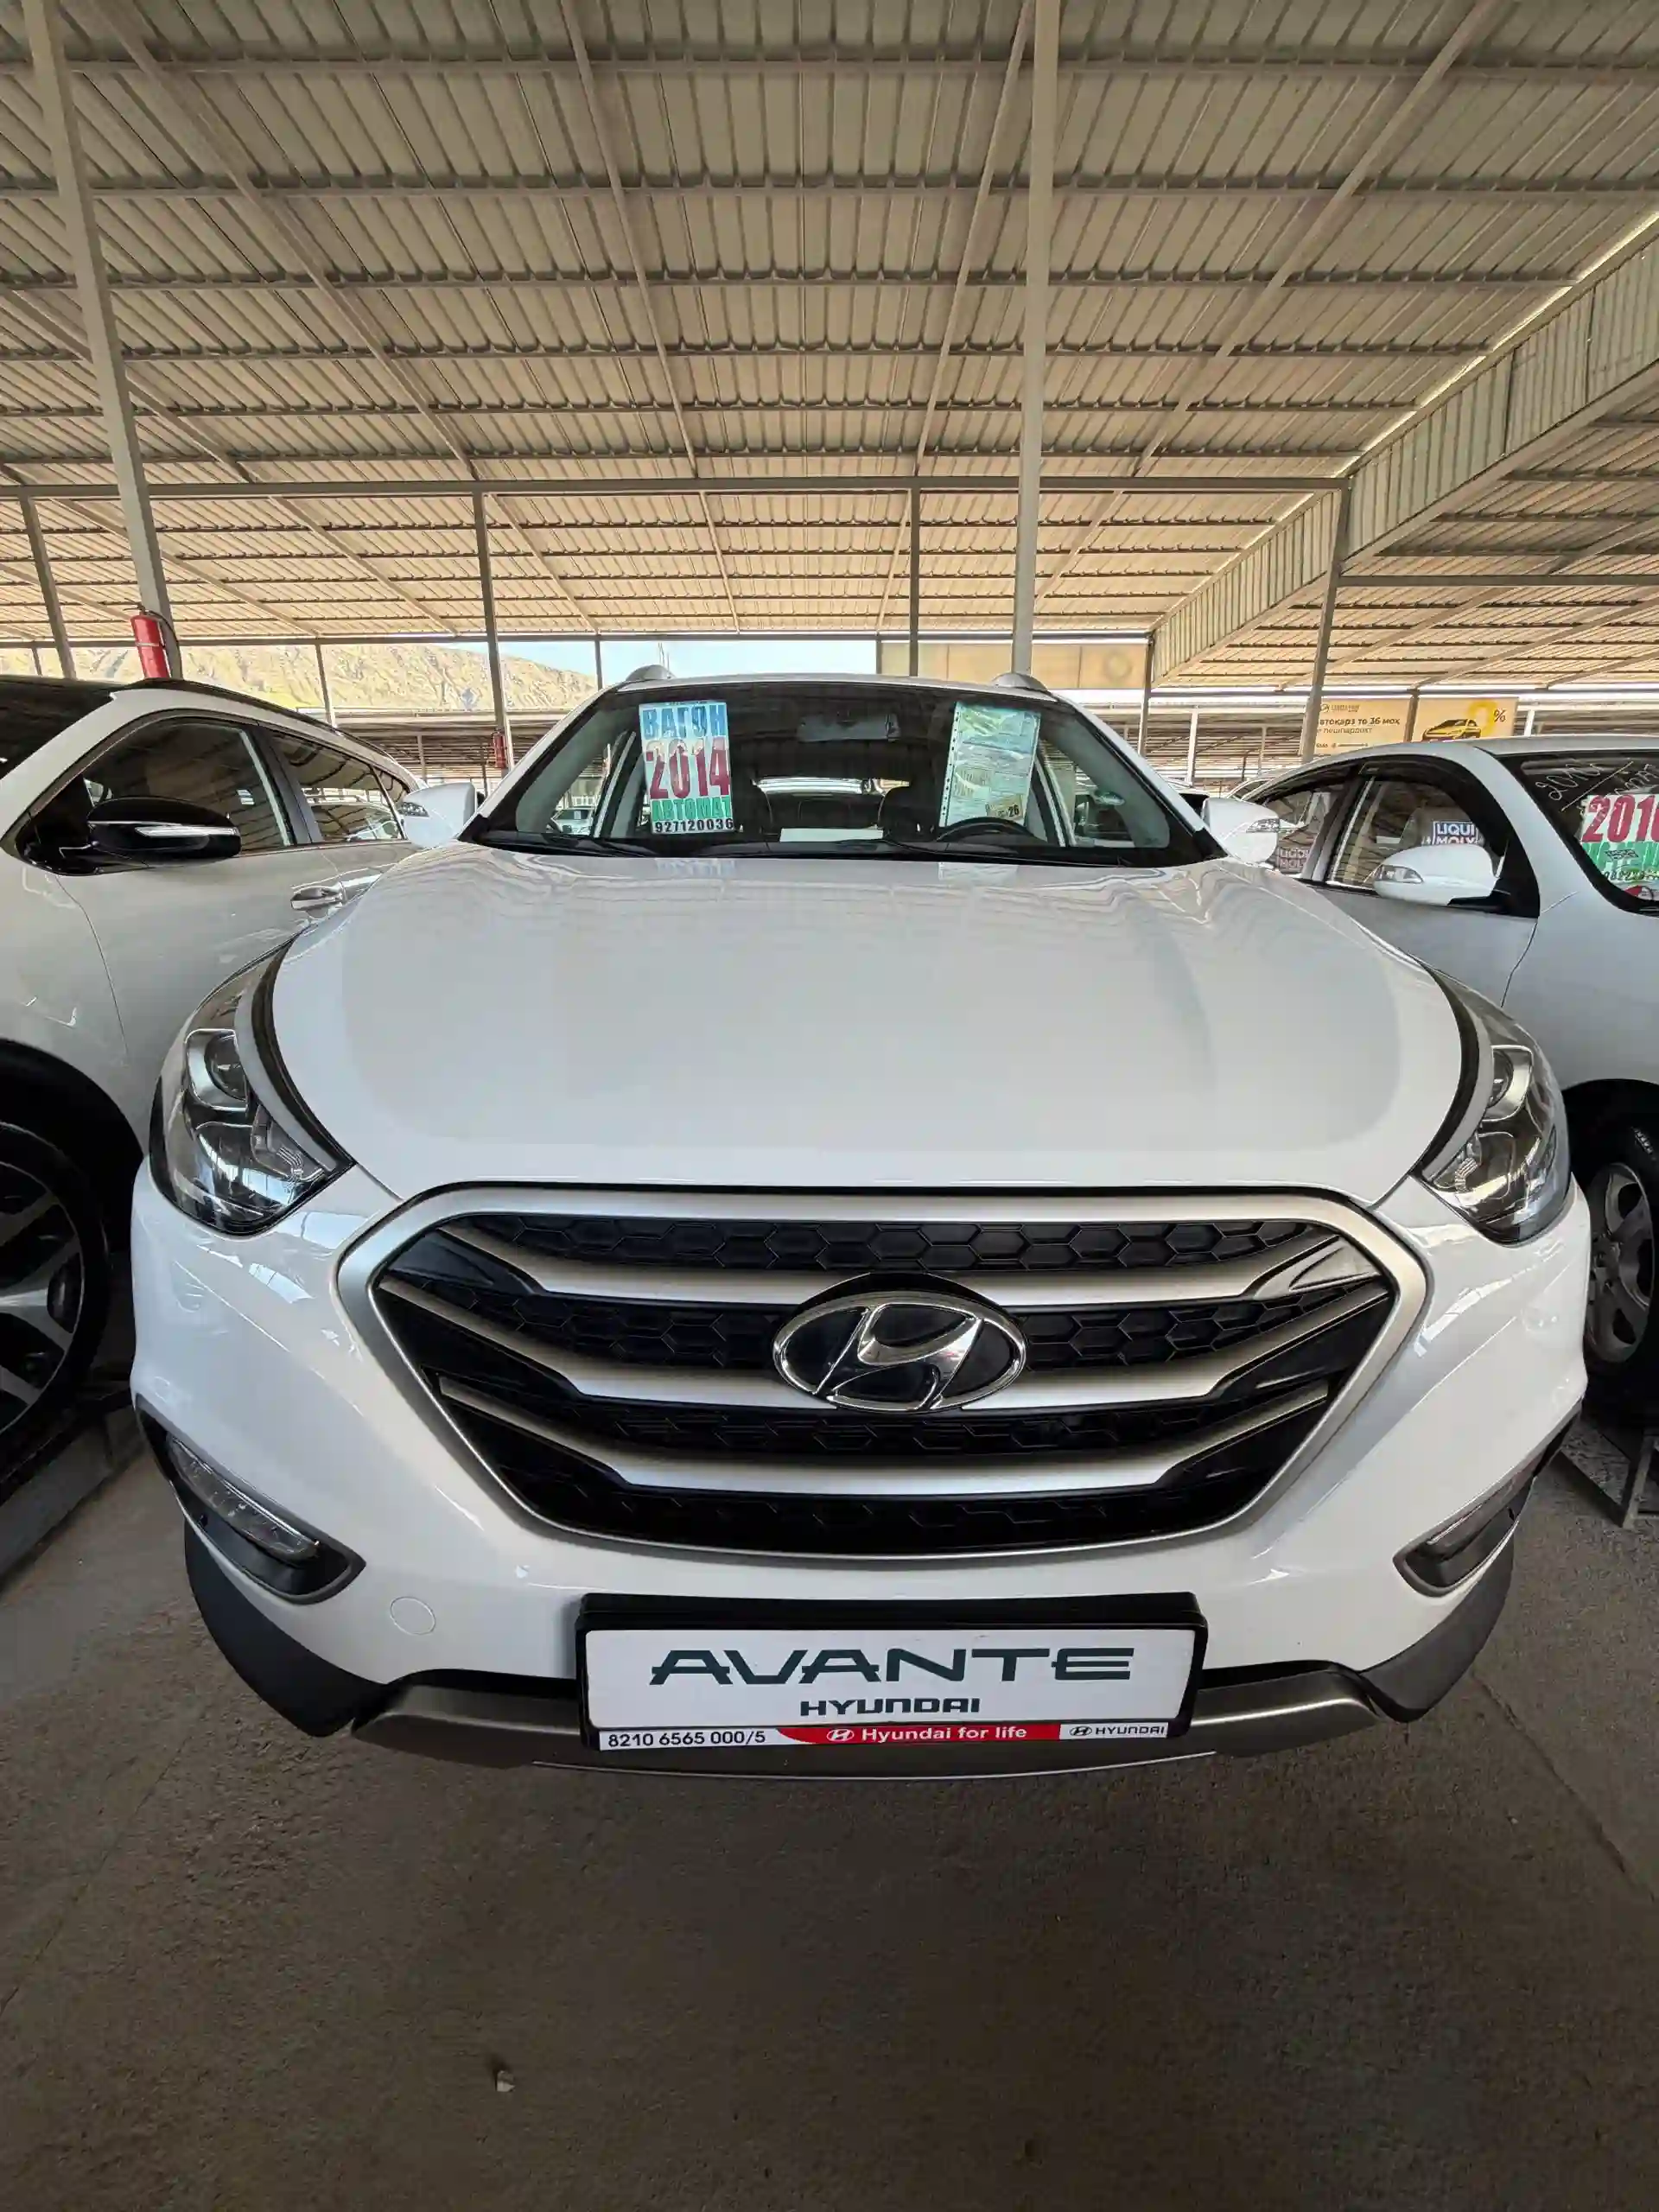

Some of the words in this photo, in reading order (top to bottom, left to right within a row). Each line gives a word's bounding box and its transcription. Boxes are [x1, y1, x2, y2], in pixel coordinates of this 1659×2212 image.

[645, 736, 731, 798] 2014
[652, 796, 732, 821] АВТОМАТ
[655, 818, 734, 833] 927120036
[1437, 823, 1475, 836] LIQUI
[649, 1648, 1135, 1685] AVANTE
[800, 1698, 981, 1716] HYUNDAI
[607, 1733, 654, 1747] 8210
[658, 1732, 705, 1745] 6565
[710, 1731, 766, 1745] 000/5
[862, 1728, 951, 1743] Hyundai
[957, 1726, 989, 1739] for
[995, 1726, 1027, 1738] life
[1095, 1726, 1165, 1735] HYUNDAI
